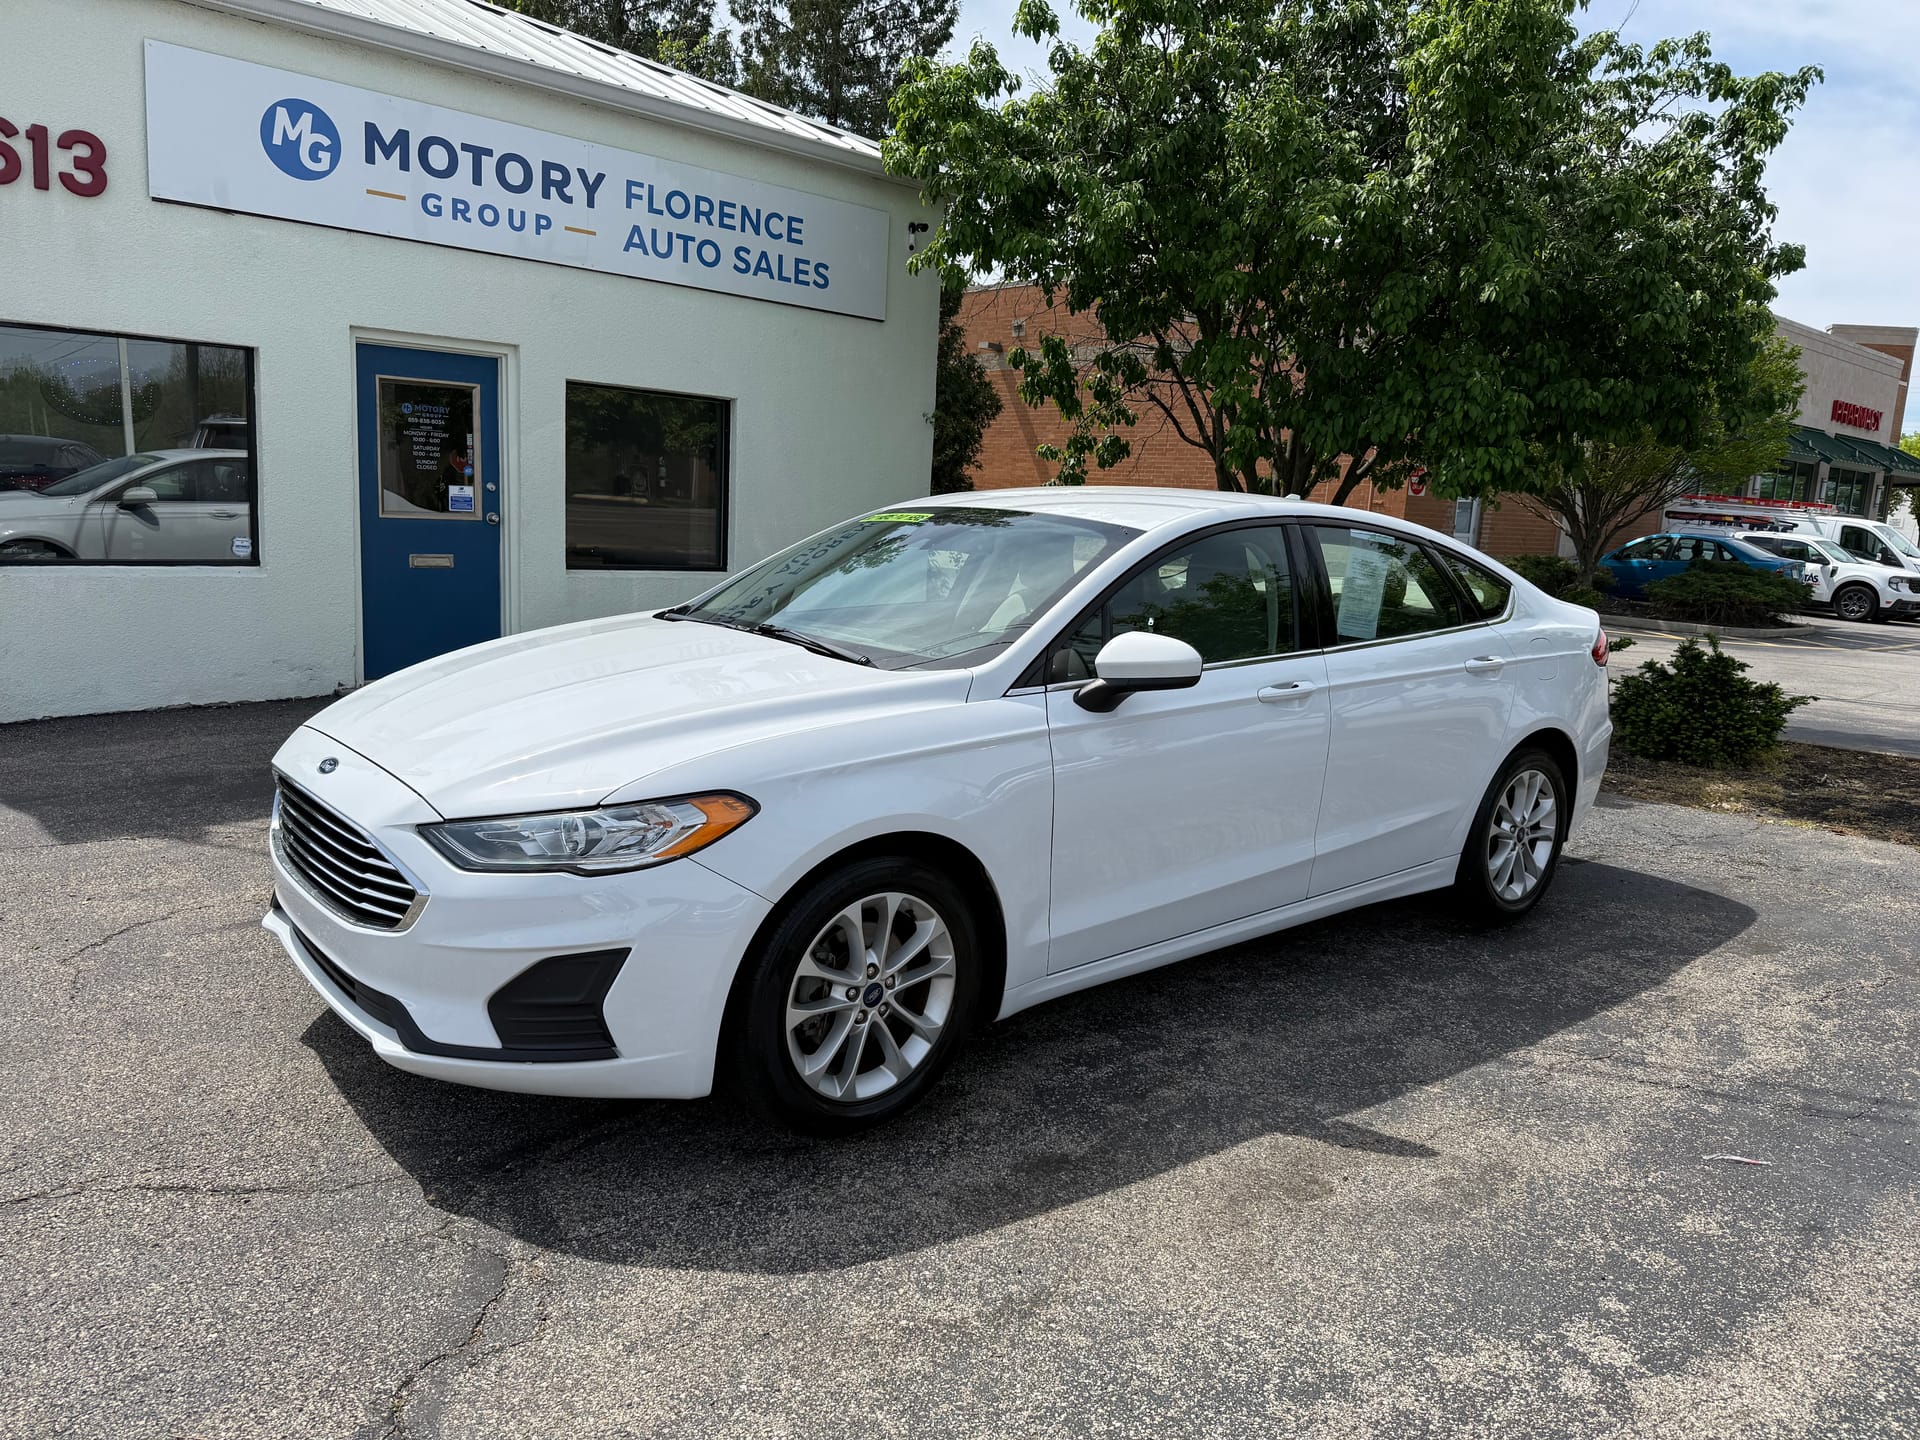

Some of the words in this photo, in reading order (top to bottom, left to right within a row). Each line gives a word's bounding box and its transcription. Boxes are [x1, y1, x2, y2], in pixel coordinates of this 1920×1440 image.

[272, 106, 331, 172] MG
[364, 121, 606, 209] MOTORY
[420, 192, 553, 236] GROUP
[625, 179, 804, 245] FLORENCE
[622, 224, 722, 268] AUTO
[732, 245, 830, 290] SALES
[414, 405, 450, 414] MOTORY
[1831, 399, 1883, 432] PHARMACY
